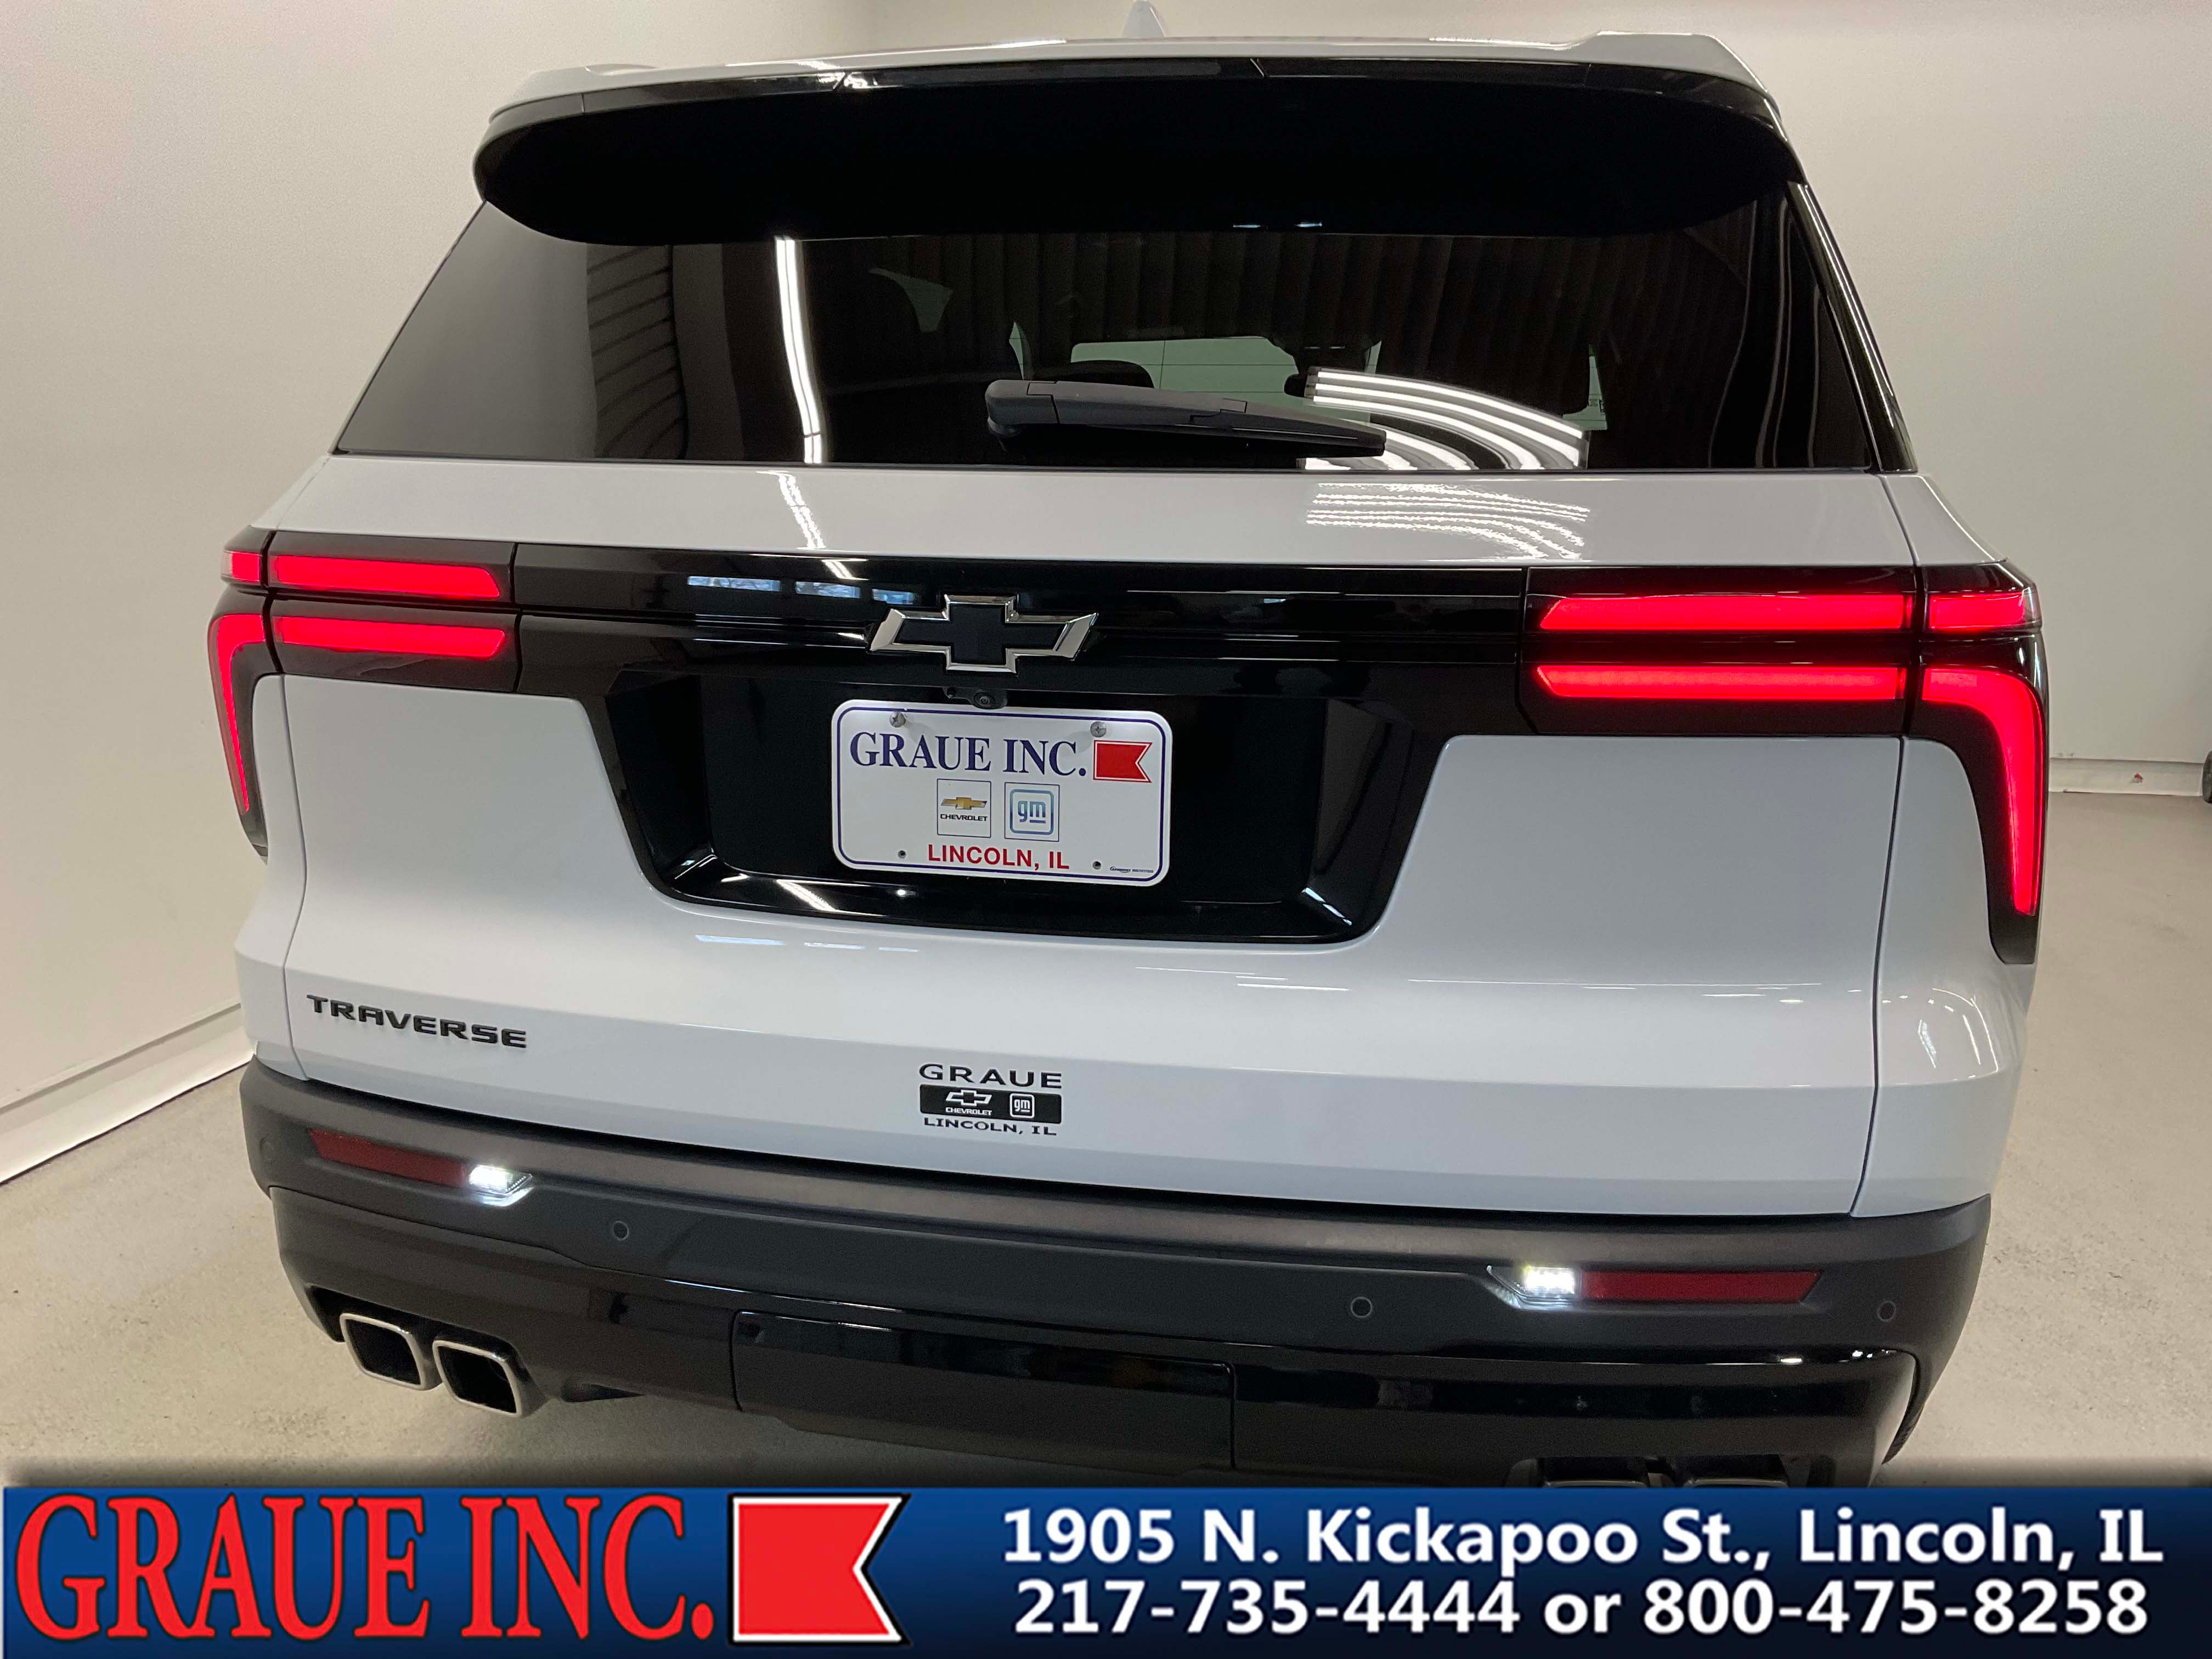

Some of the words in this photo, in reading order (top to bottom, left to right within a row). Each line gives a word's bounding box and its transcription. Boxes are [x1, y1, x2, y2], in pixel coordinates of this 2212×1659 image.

[850, 732, 991, 771] GRAUE
[1003, 740, 1086, 777] INC.
[940, 814, 988, 822] CHEVROLET
[1018, 801, 1046, 823] gm
[928, 844, 1040, 870] LINCOLN,
[1049, 852, 1070, 870] IL
[307, 995, 527, 1048] TRAVERSE
[919, 1063, 1062, 1089] GRAUE
[945, 1107, 992, 1115] CHEVROLET
[1014, 1098, 1030, 1113] gm
[924, 1117, 1023, 1135] LINCOLN,
[1031, 1126, 1057, 1136] IL
